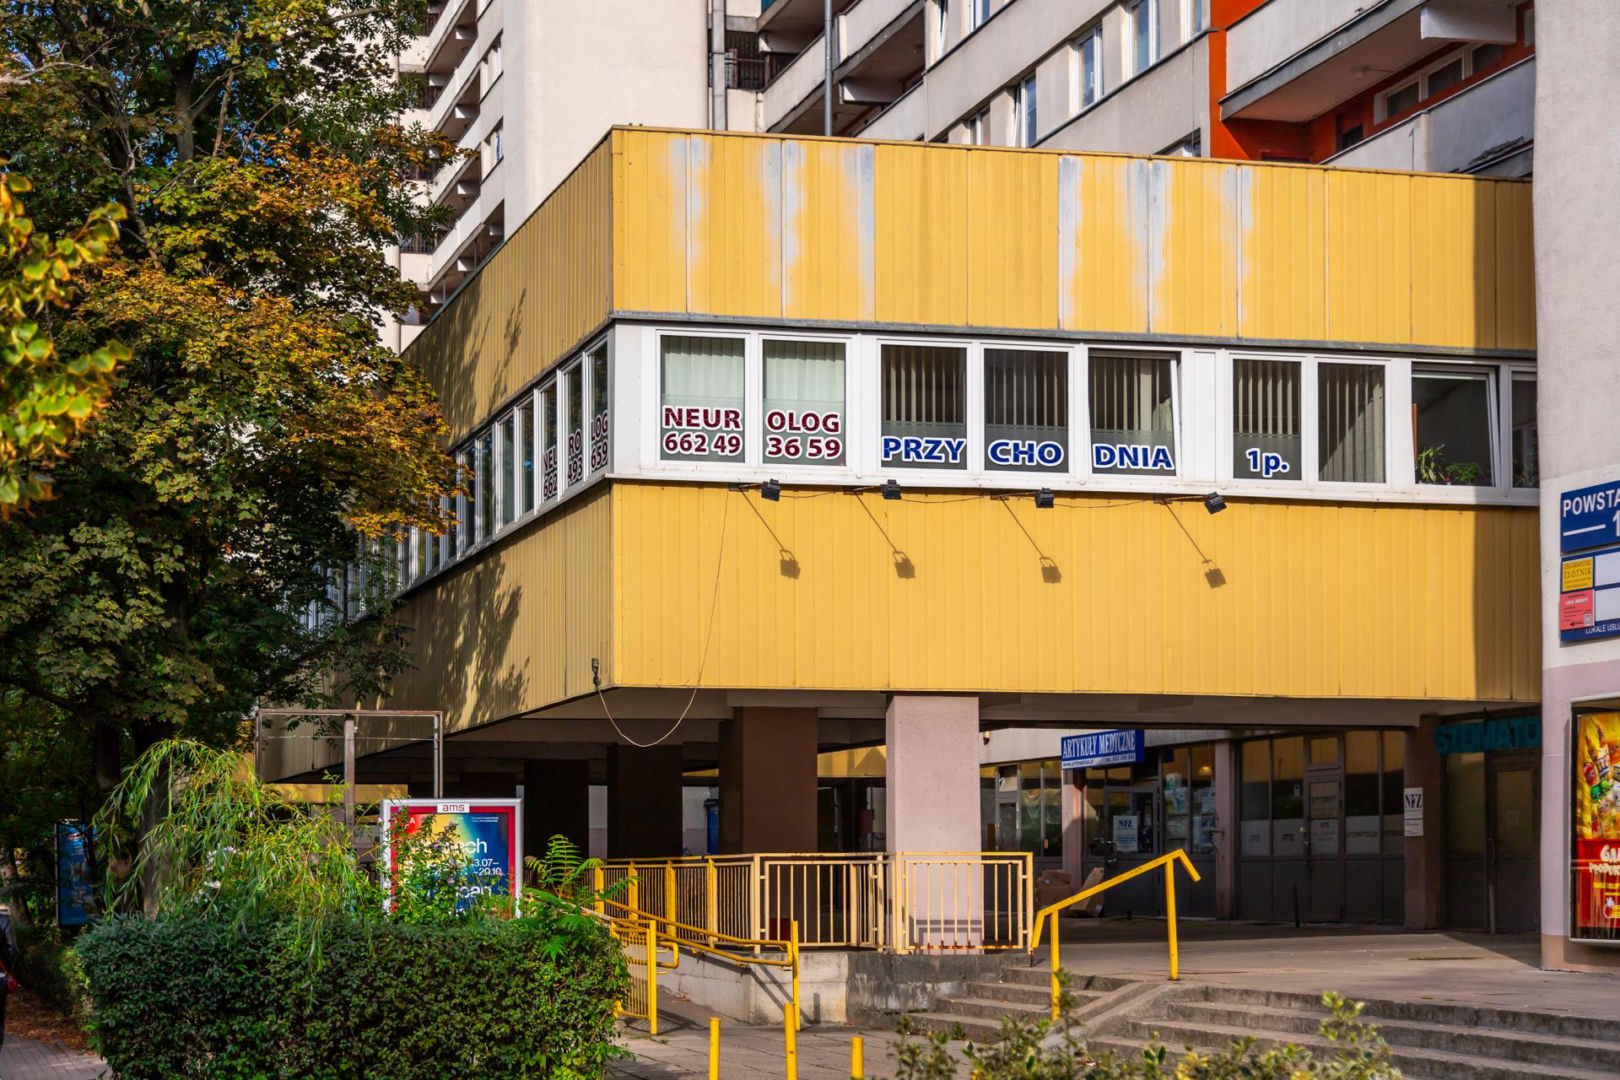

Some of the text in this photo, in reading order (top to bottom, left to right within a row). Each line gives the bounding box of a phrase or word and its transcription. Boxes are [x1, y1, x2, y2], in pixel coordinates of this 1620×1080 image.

[568, 430, 582, 457] RO
[591, 411, 609, 441] LOG
[663, 406, 841, 434] NEUR OLOG
[664, 432, 841, 458] 662 49 36 59
[882, 437, 965, 462] PRZY
[989, 440, 1063, 465] CHO
[1094, 445, 1173, 468] DNIA
[543, 440, 609, 499] 662 493 659
[442, 804, 465, 812] ams
[1405, 794, 1423, 809] NFZ
